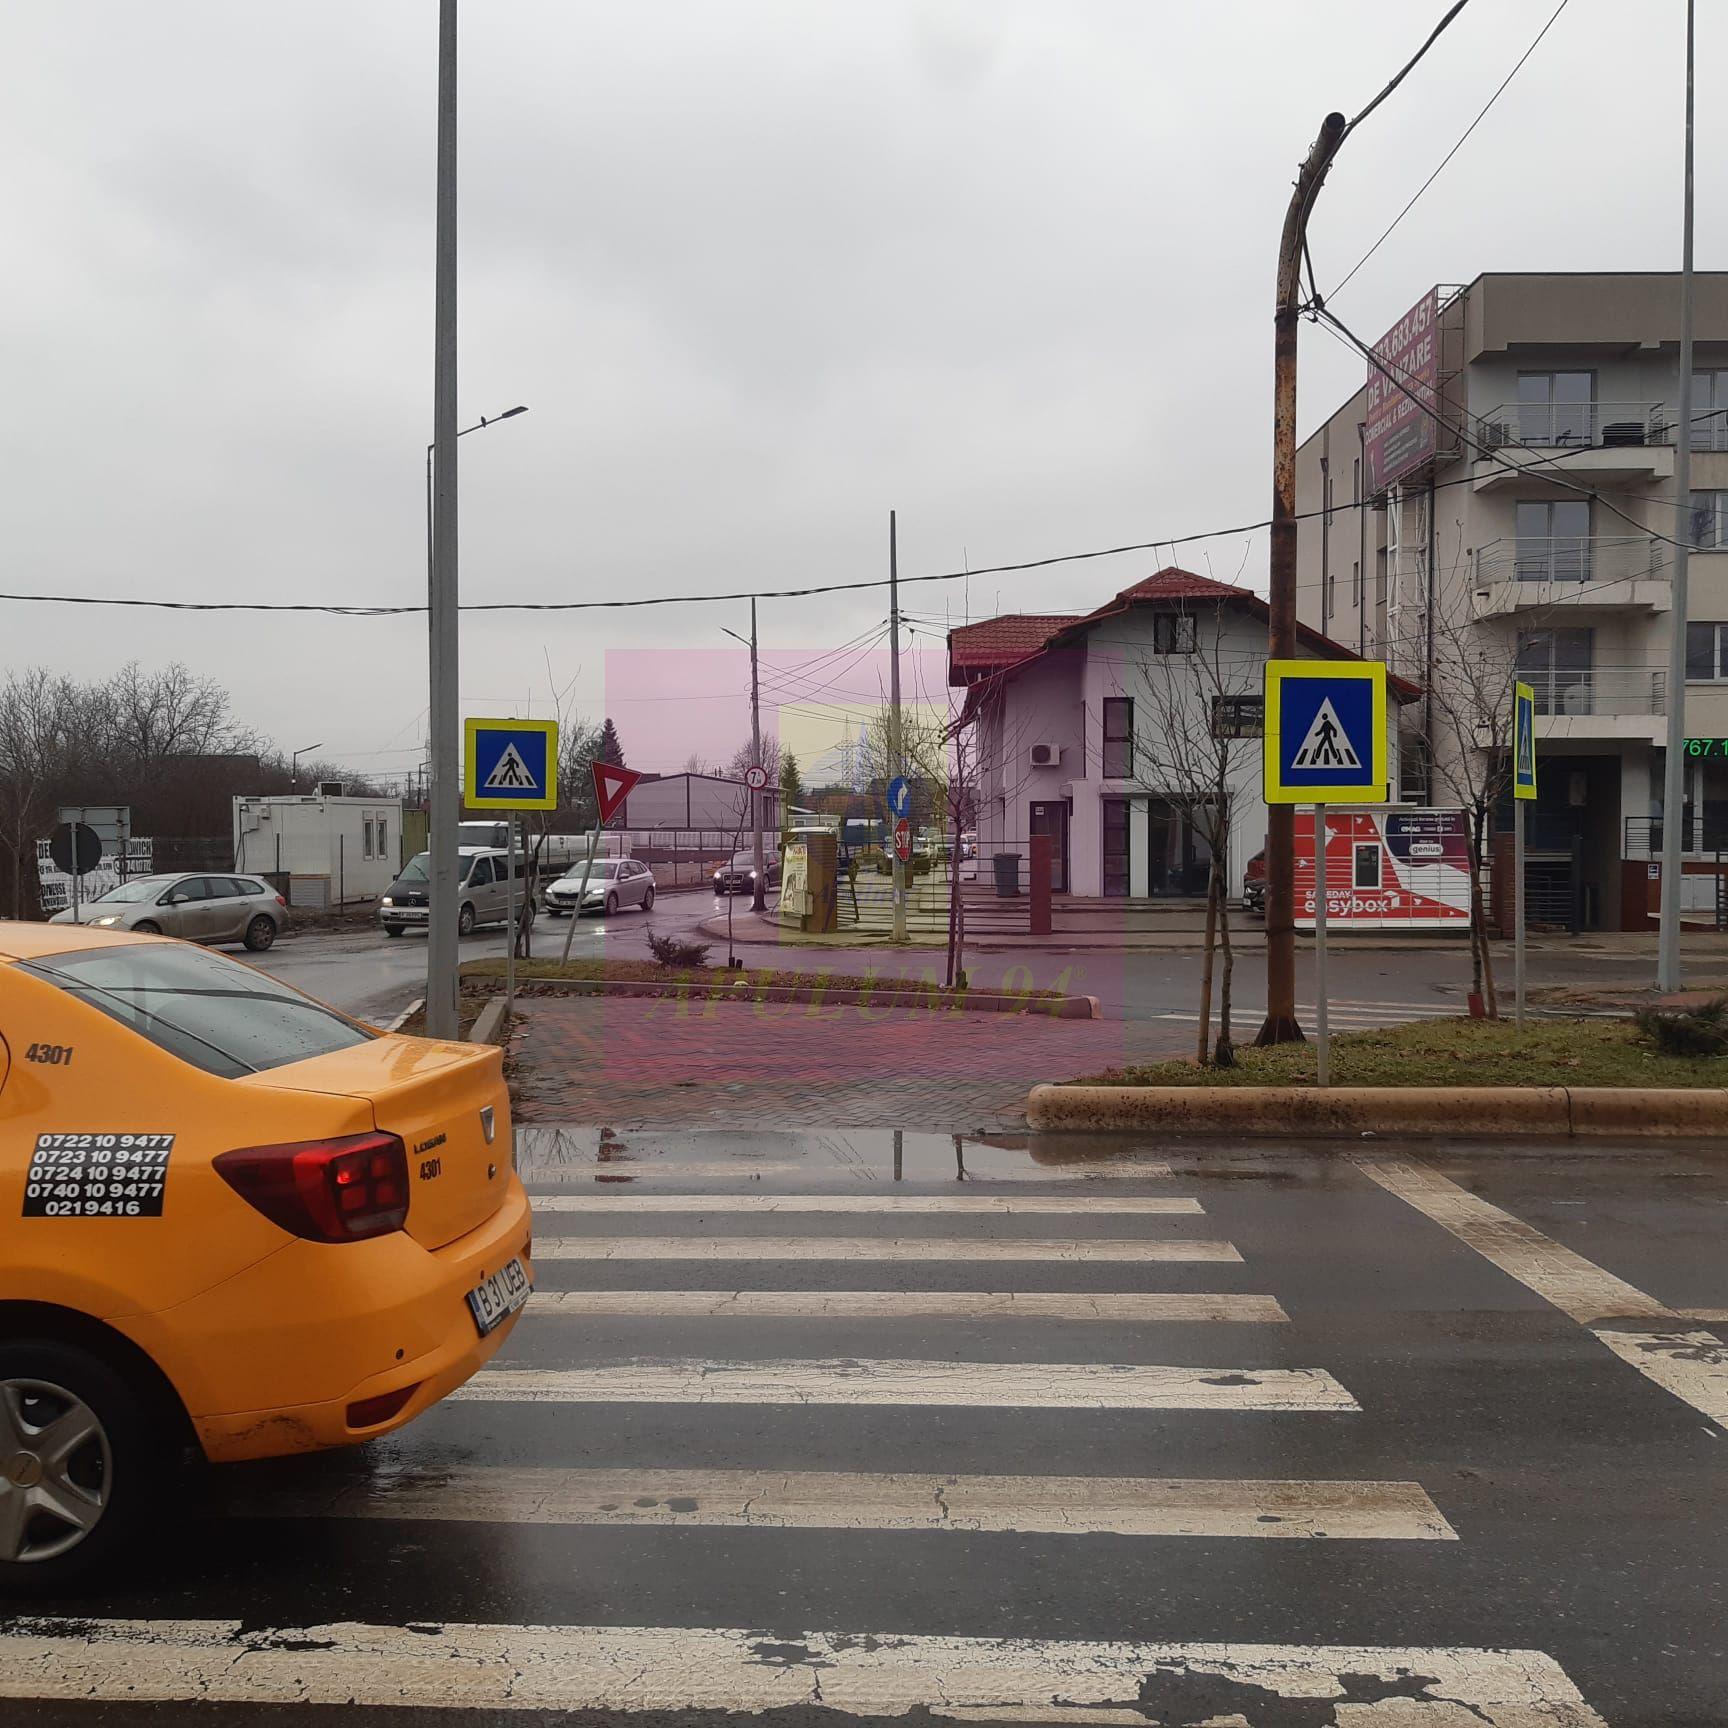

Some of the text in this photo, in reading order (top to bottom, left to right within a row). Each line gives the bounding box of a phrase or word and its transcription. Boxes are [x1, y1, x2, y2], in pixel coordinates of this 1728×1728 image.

[1368, 381, 1380, 412] DE
[1382, 335, 1432, 397] VANZARE
[896, 831, 910, 849] STOP
[1412, 845, 1440, 854] genius
[1306, 891, 1351, 899] SAEDAY
[1305, 896, 1389, 916] esybox
[24, 1043, 74, 1066] 4301
[38, 1134, 174, 1148] 0722 10 9477
[33, 1150, 169, 1164] 0723 10 9477
[29, 1166, 166, 1181] 0724 10 9477
[420, 1157, 442, 1180] 4301
[26, 1183, 163, 1198] 0740 10 9477
[477, 1286, 493, 1317] B
[488, 1275, 505, 1308] 31
[500, 1258, 525, 1296] UEB
